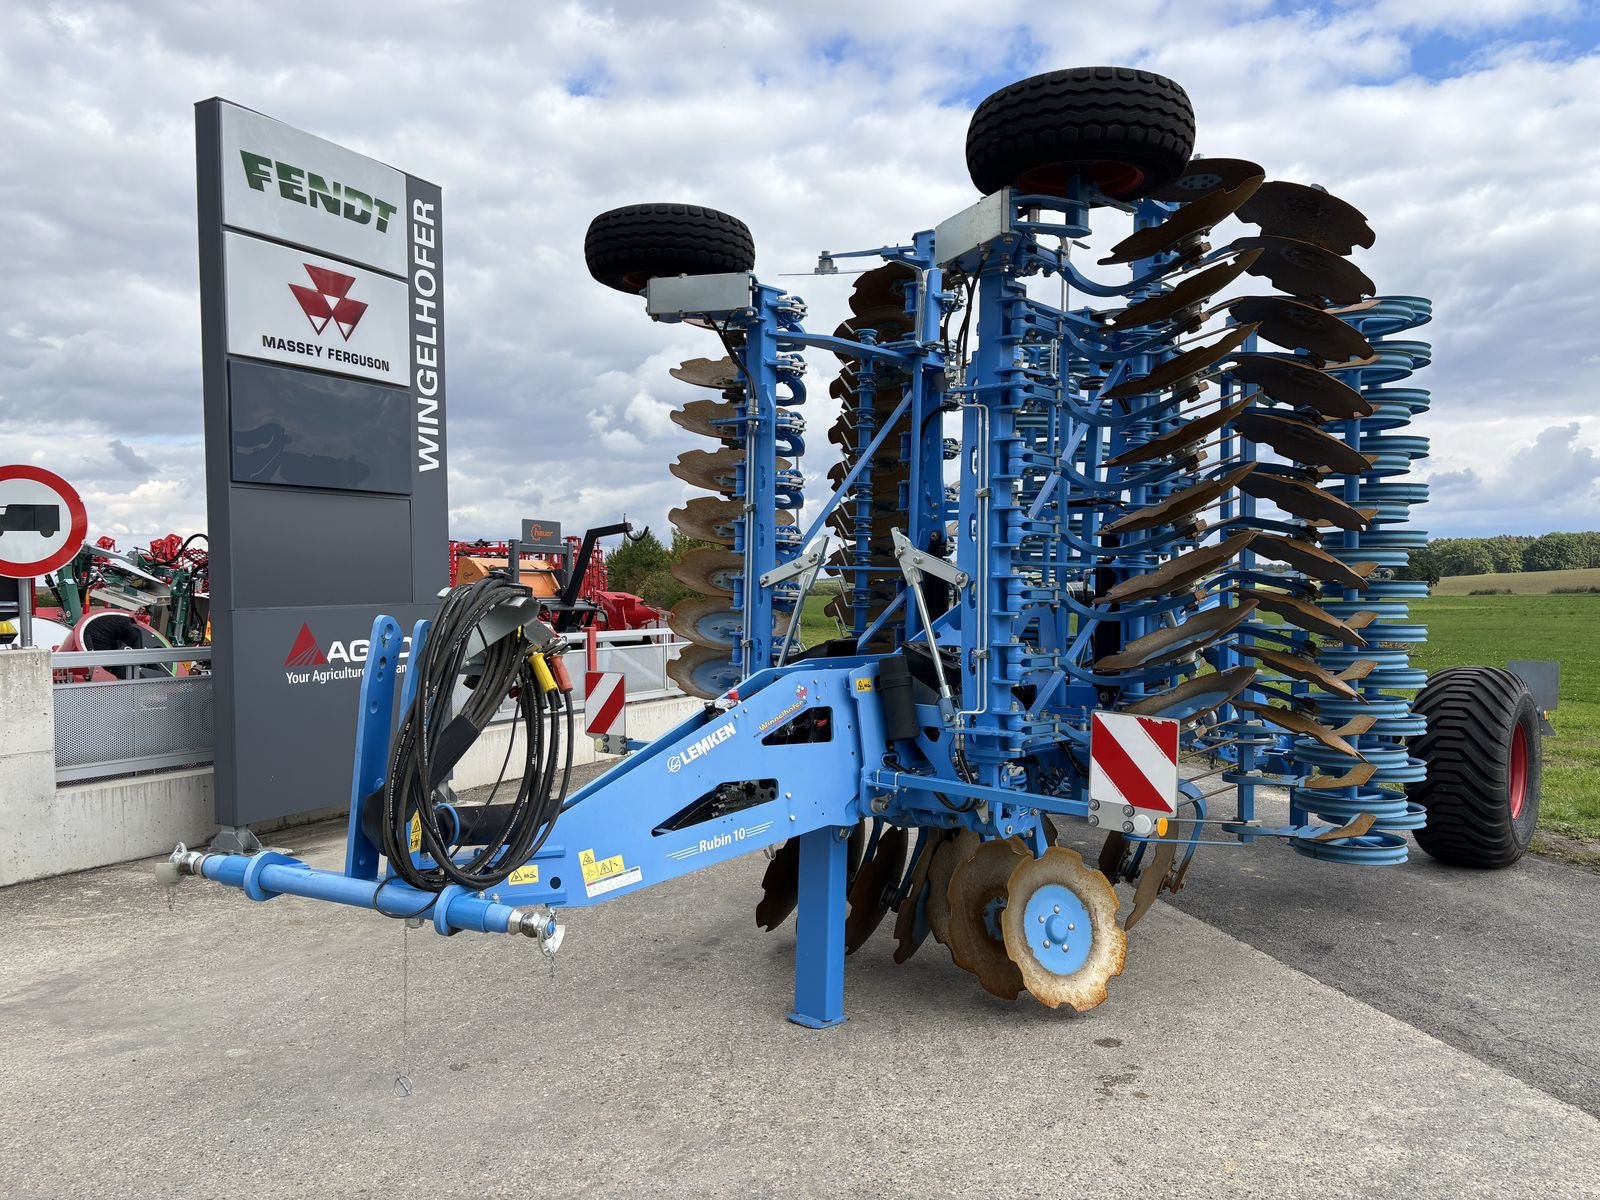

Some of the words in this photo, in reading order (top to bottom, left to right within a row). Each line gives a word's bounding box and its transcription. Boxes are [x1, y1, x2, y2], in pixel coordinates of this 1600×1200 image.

[240, 149, 397, 233] FENDT
[262, 334, 323, 358] MASSEY
[328, 347, 390, 372] FERGUSON
[413, 198, 439, 473] WINGELHOFER
[326, 636, 413, 664] AGO
[286, 671, 310, 684] Your
[679, 722, 737, 765] LEMKEN
[699, 834, 732, 853] Rubin
[733, 828, 746, 841] 10
